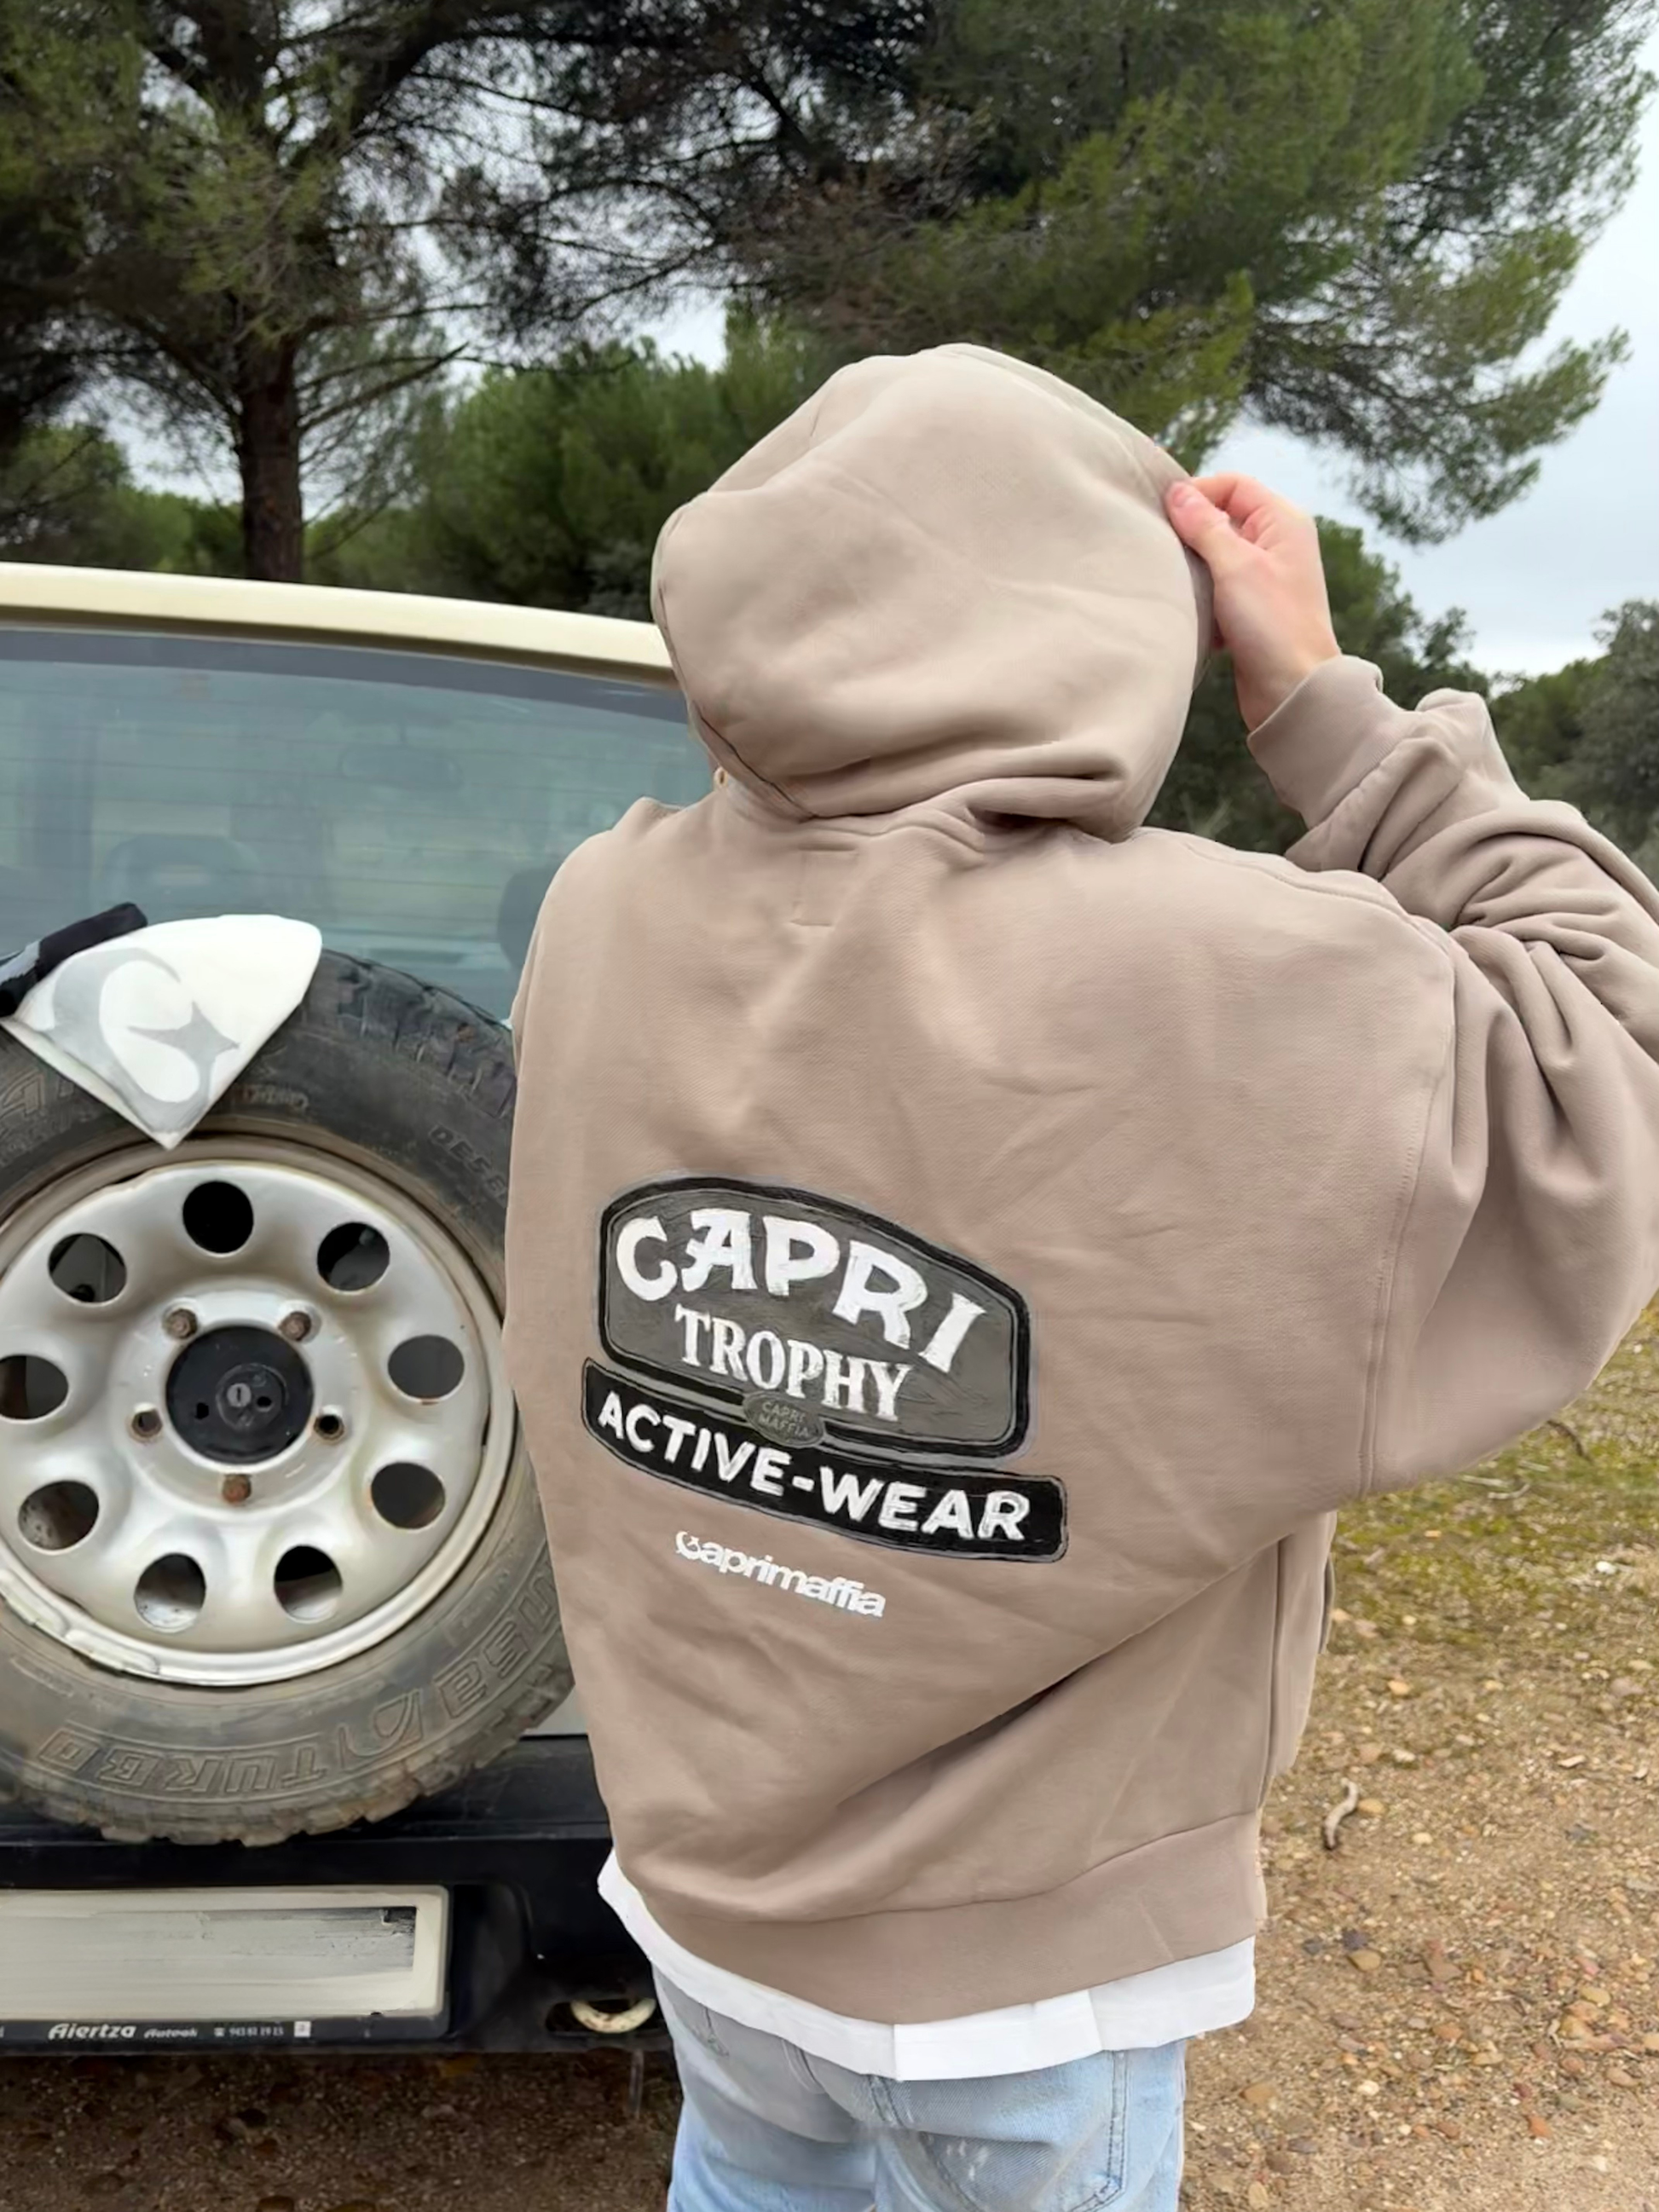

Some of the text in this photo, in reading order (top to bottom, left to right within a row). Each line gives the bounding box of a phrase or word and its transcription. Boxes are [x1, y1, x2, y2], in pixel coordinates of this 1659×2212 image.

[615, 1207, 987, 1373] CAPRI
[674, 1302, 912, 1423] TROPHY
[598, 1391, 1032, 1541] ACTIVE-WEAR
[38, 1729, 330, 1793] TURBO
[48, 2022, 137, 2041] Aiertza
